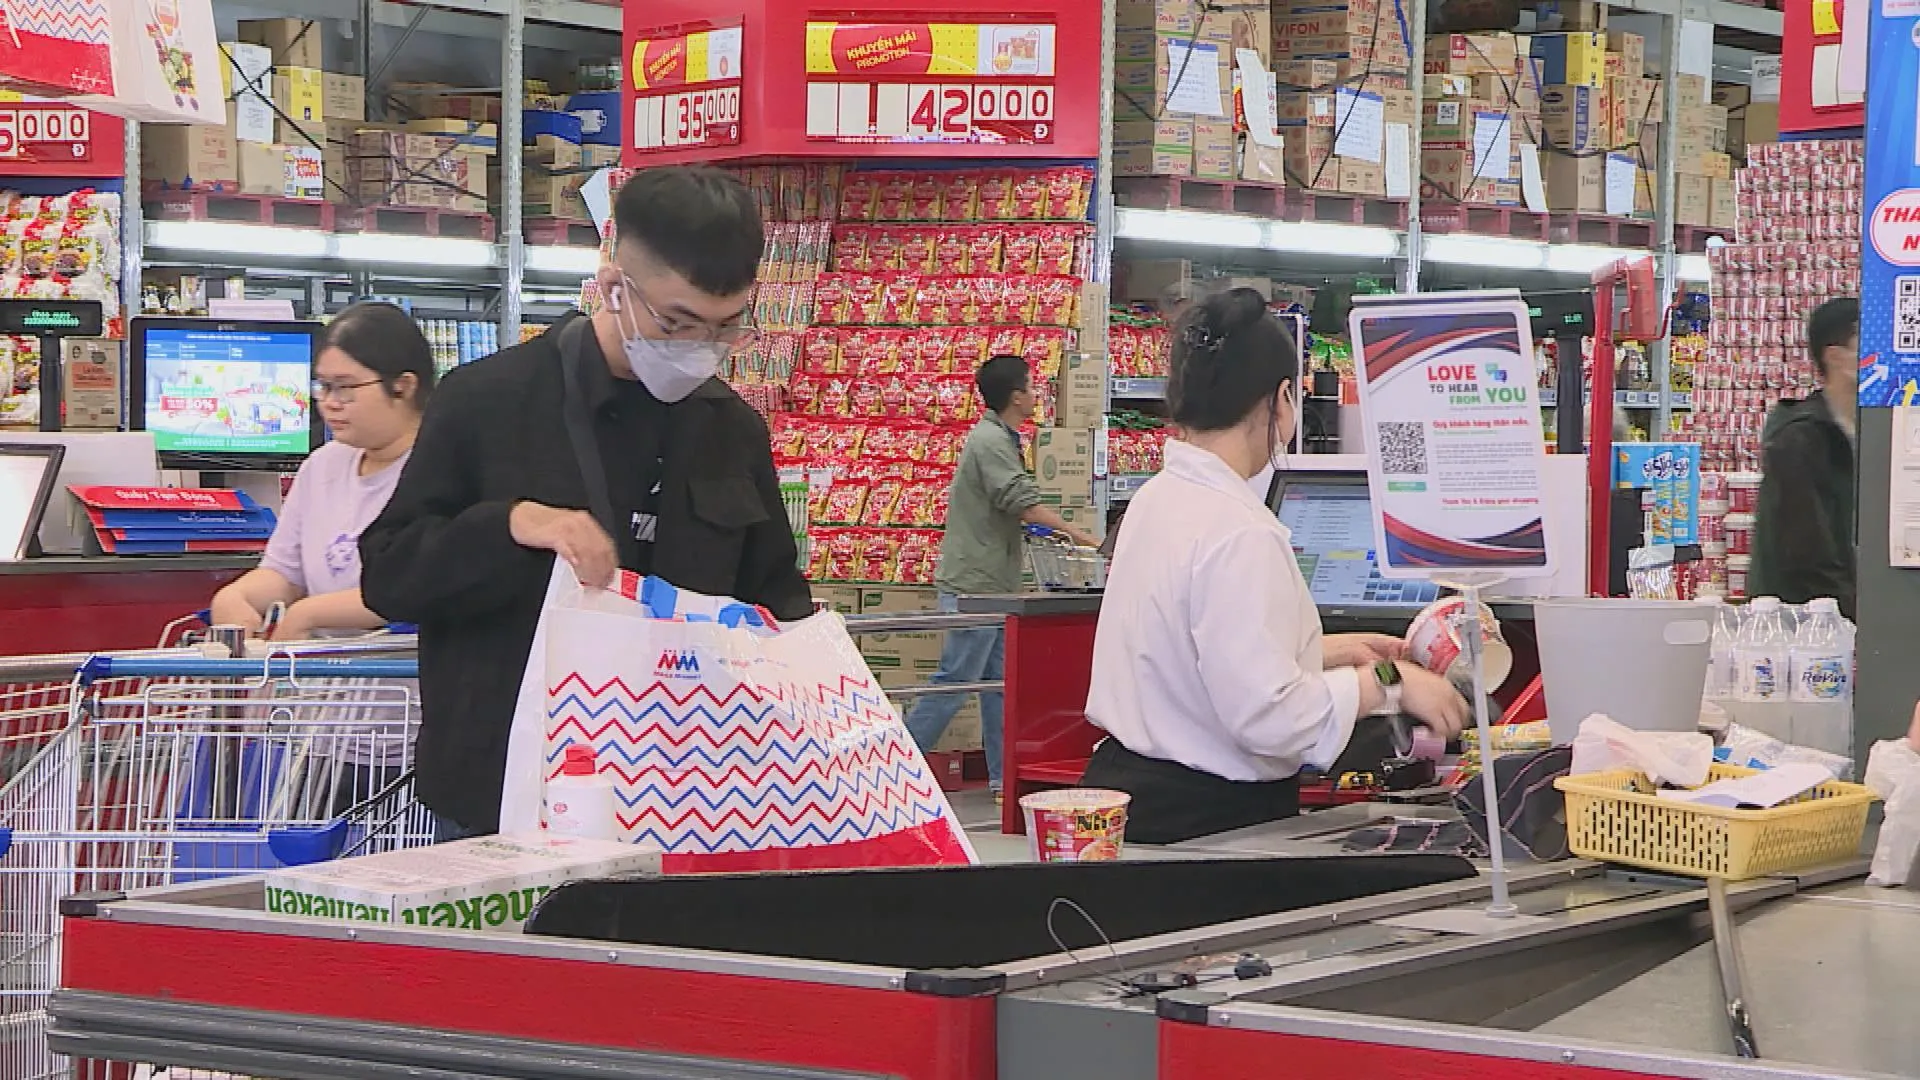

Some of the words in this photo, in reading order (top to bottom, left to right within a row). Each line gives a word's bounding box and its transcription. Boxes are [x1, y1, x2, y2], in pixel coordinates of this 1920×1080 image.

[1275, 22, 1319, 34] VIFON
[856, 47, 911, 69] PROMOTION
[1428, 366, 1476, 381] LOVE
[1430, 384, 1444, 392] TO
[1449, 384, 1478, 392] HEAR
[1450, 396, 1480, 405] FROM
[1486, 387, 1526, 402] YOU
